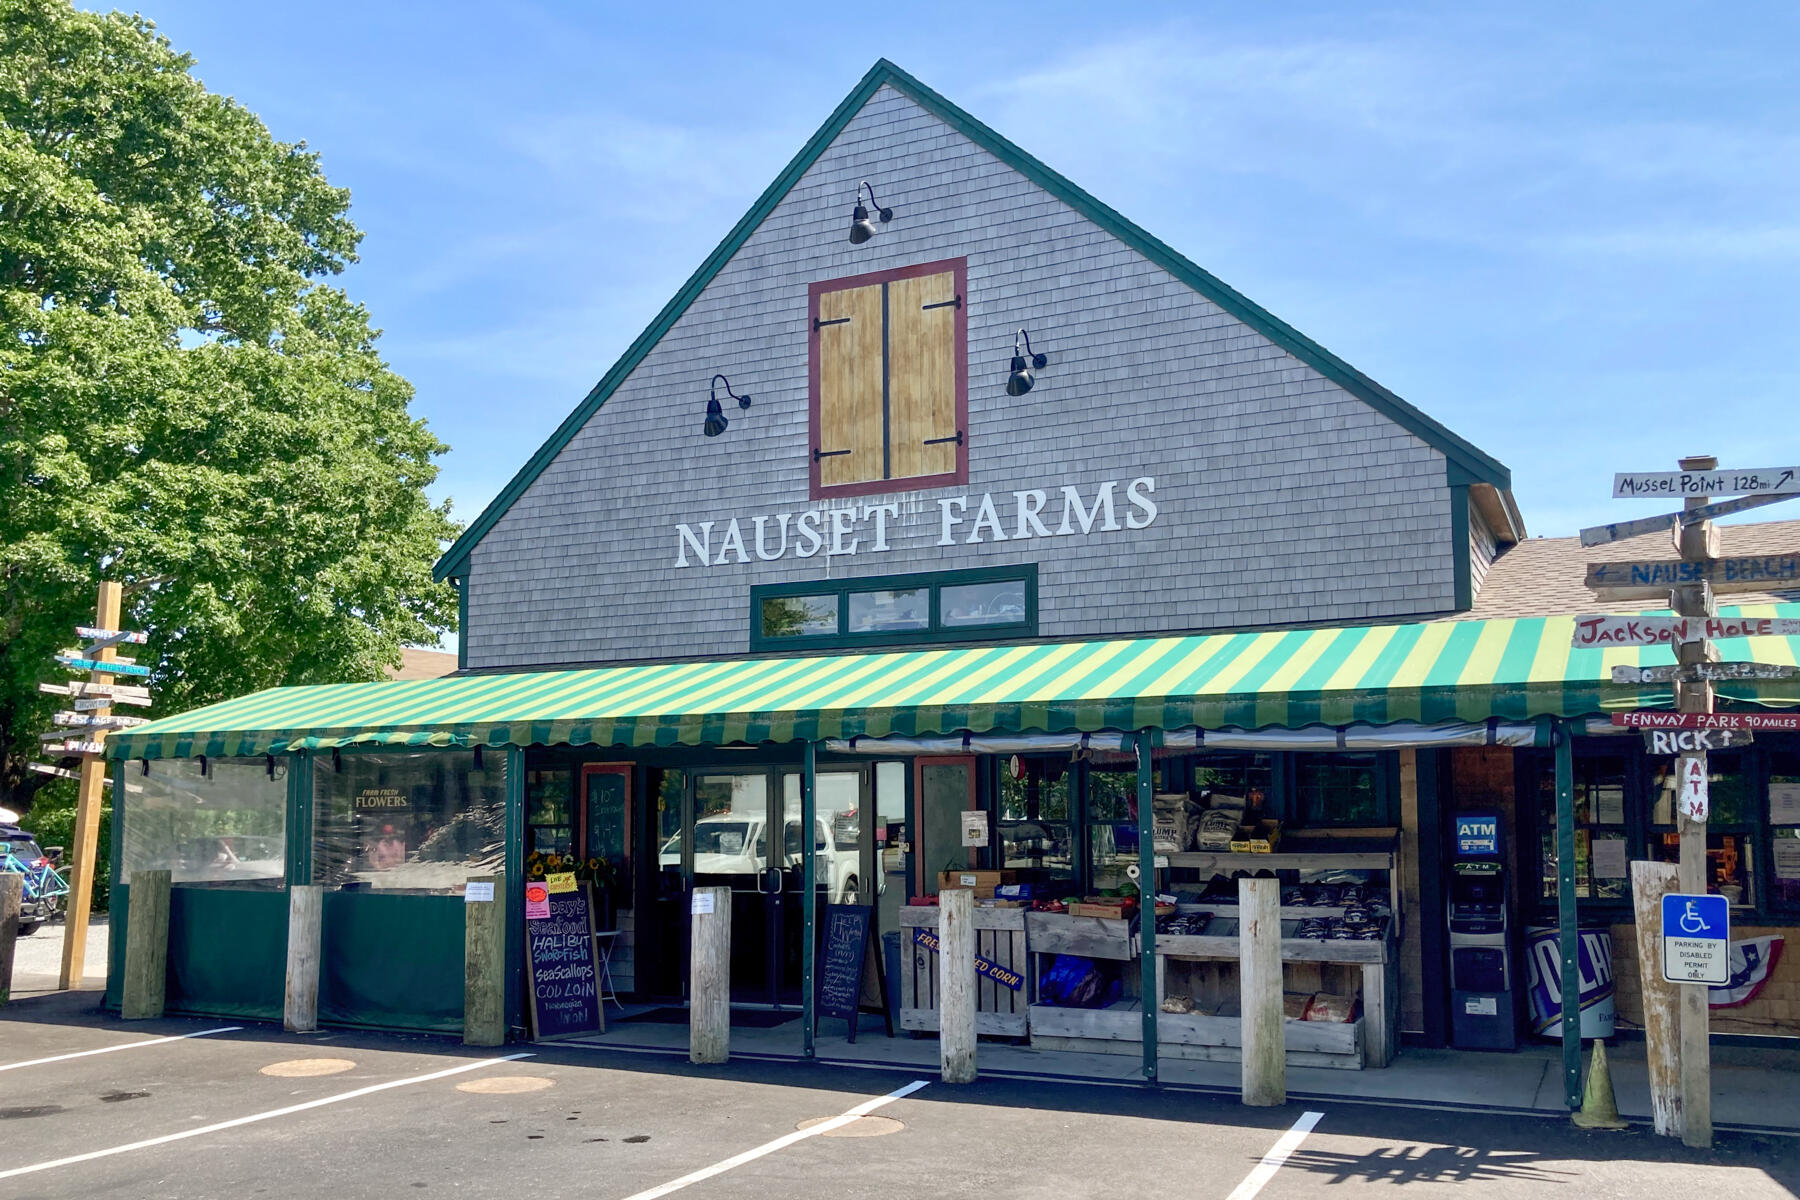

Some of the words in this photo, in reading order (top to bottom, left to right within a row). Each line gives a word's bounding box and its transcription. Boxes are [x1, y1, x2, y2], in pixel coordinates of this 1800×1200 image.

[674, 502, 898, 568] NAUSET
[937, 476, 1159, 546] FARMS
[1725, 557, 1796, 581] BEACH
[1579, 617, 1689, 644] JACKSON
[1623, 713, 1688, 726] FENWAY
[1697, 714, 1739, 727] PARK
[1744, 716, 1761, 727] 90
[1761, 717, 1798, 728] MILES
[1652, 729, 1714, 755] RICK
[355, 796, 408, 808] FLOWERS
[1458, 823, 1496, 836] ATM
[529, 915, 588, 935] Seafood
[532, 935, 591, 950] HALIBUT
[917, 932, 940, 950] FRES
[1674, 941, 1704, 949] PARKING
[1679, 951, 1713, 959] DISABLED
[1684, 961, 1709, 969] PERMIT
[989, 966, 1019, 986] CORN
